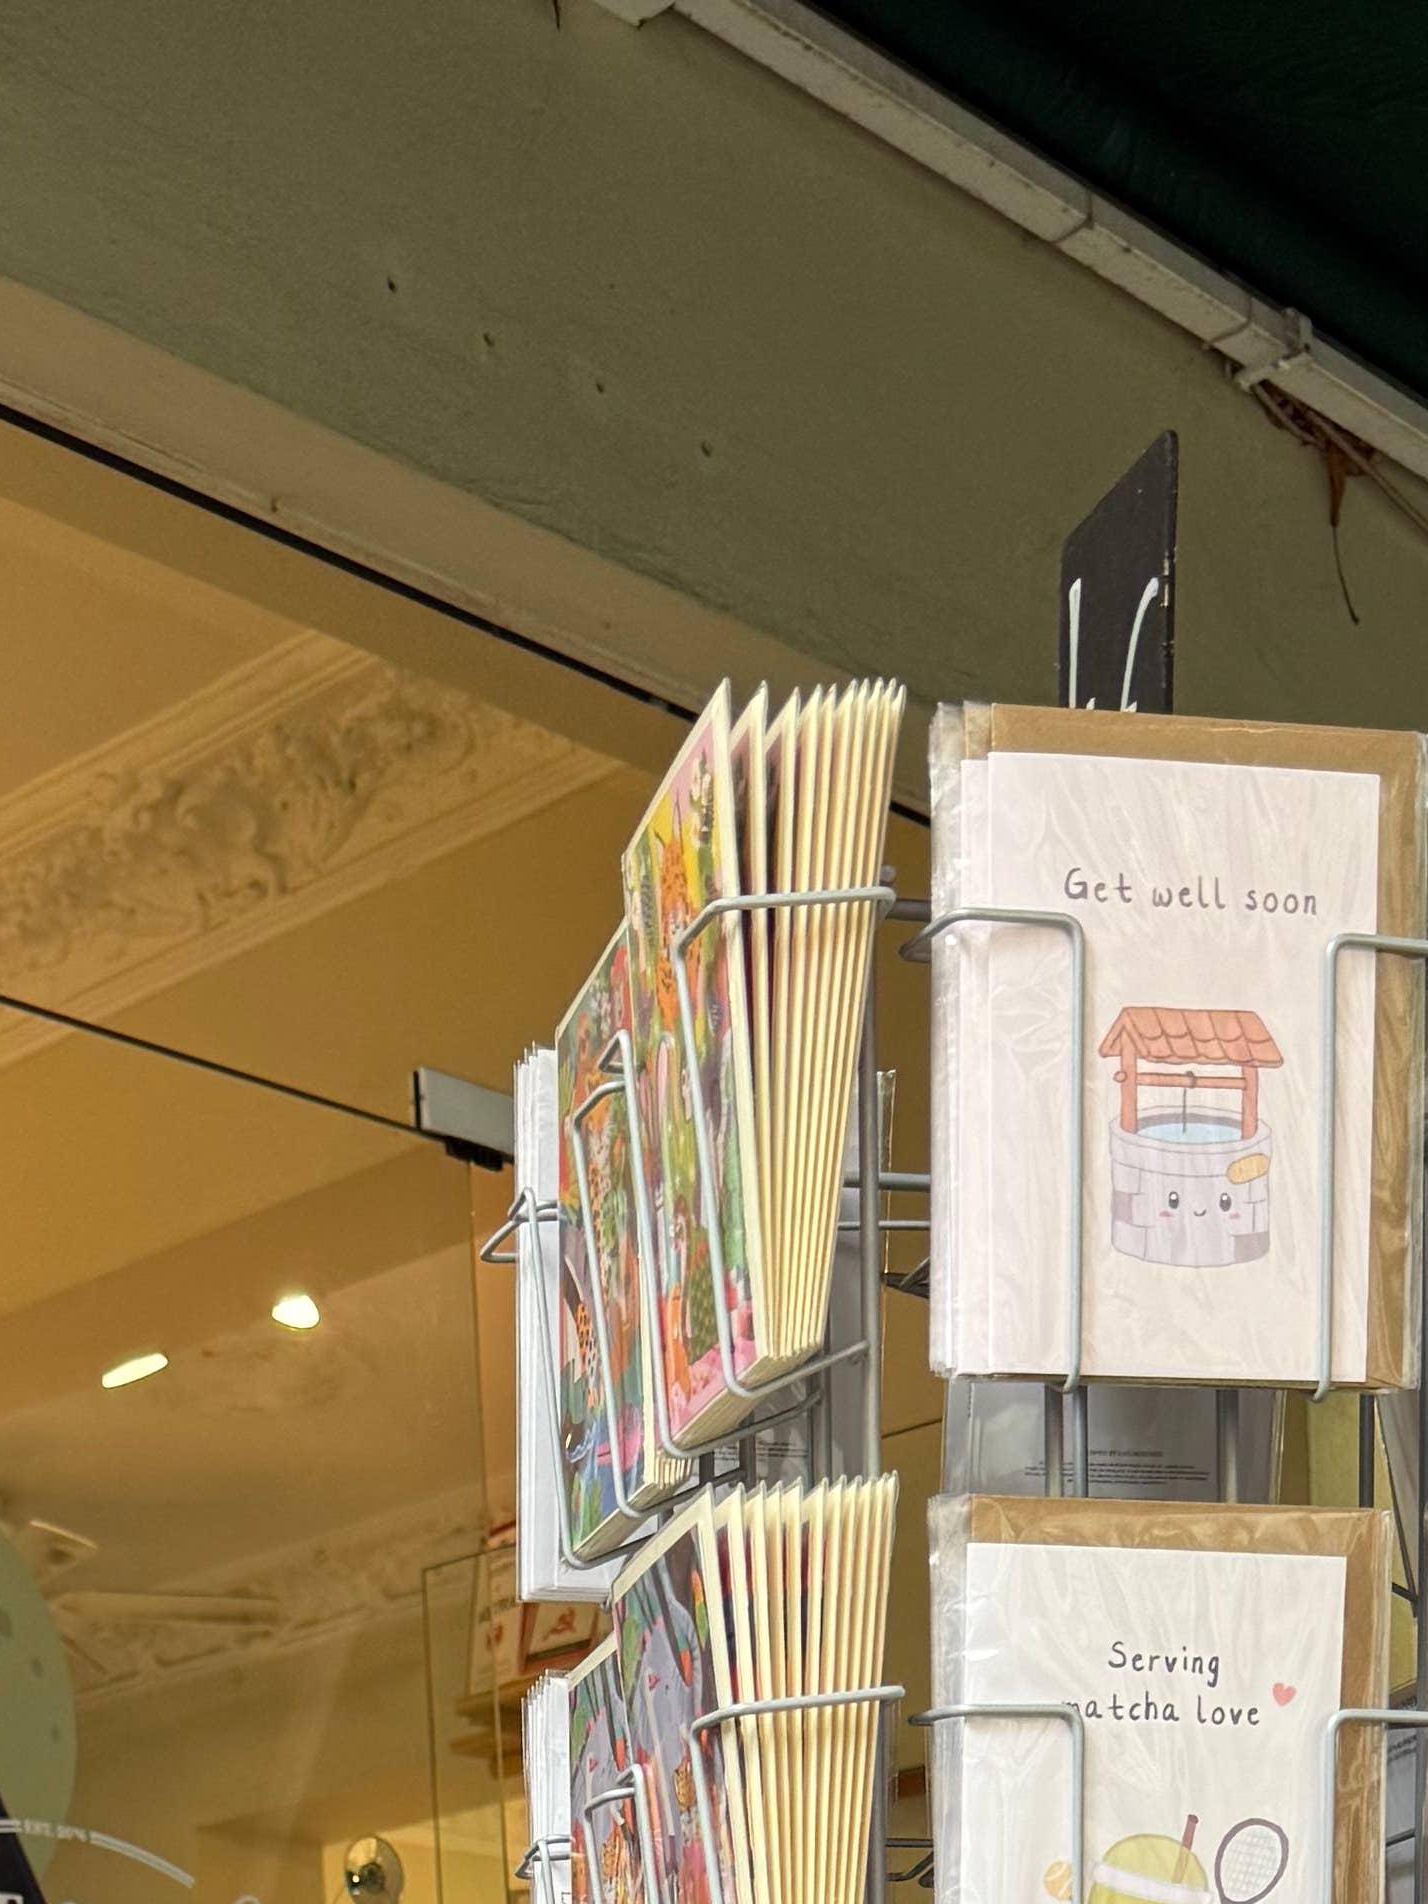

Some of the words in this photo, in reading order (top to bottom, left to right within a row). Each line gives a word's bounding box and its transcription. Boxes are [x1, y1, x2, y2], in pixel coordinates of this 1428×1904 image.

[1064, 867, 1131, 902] Get
[1152, 878, 1226, 910] well
[1246, 886, 1317, 916] soon
[1109, 1641, 1221, 1690] Serving
[1196, 1696, 1261, 1728] love
